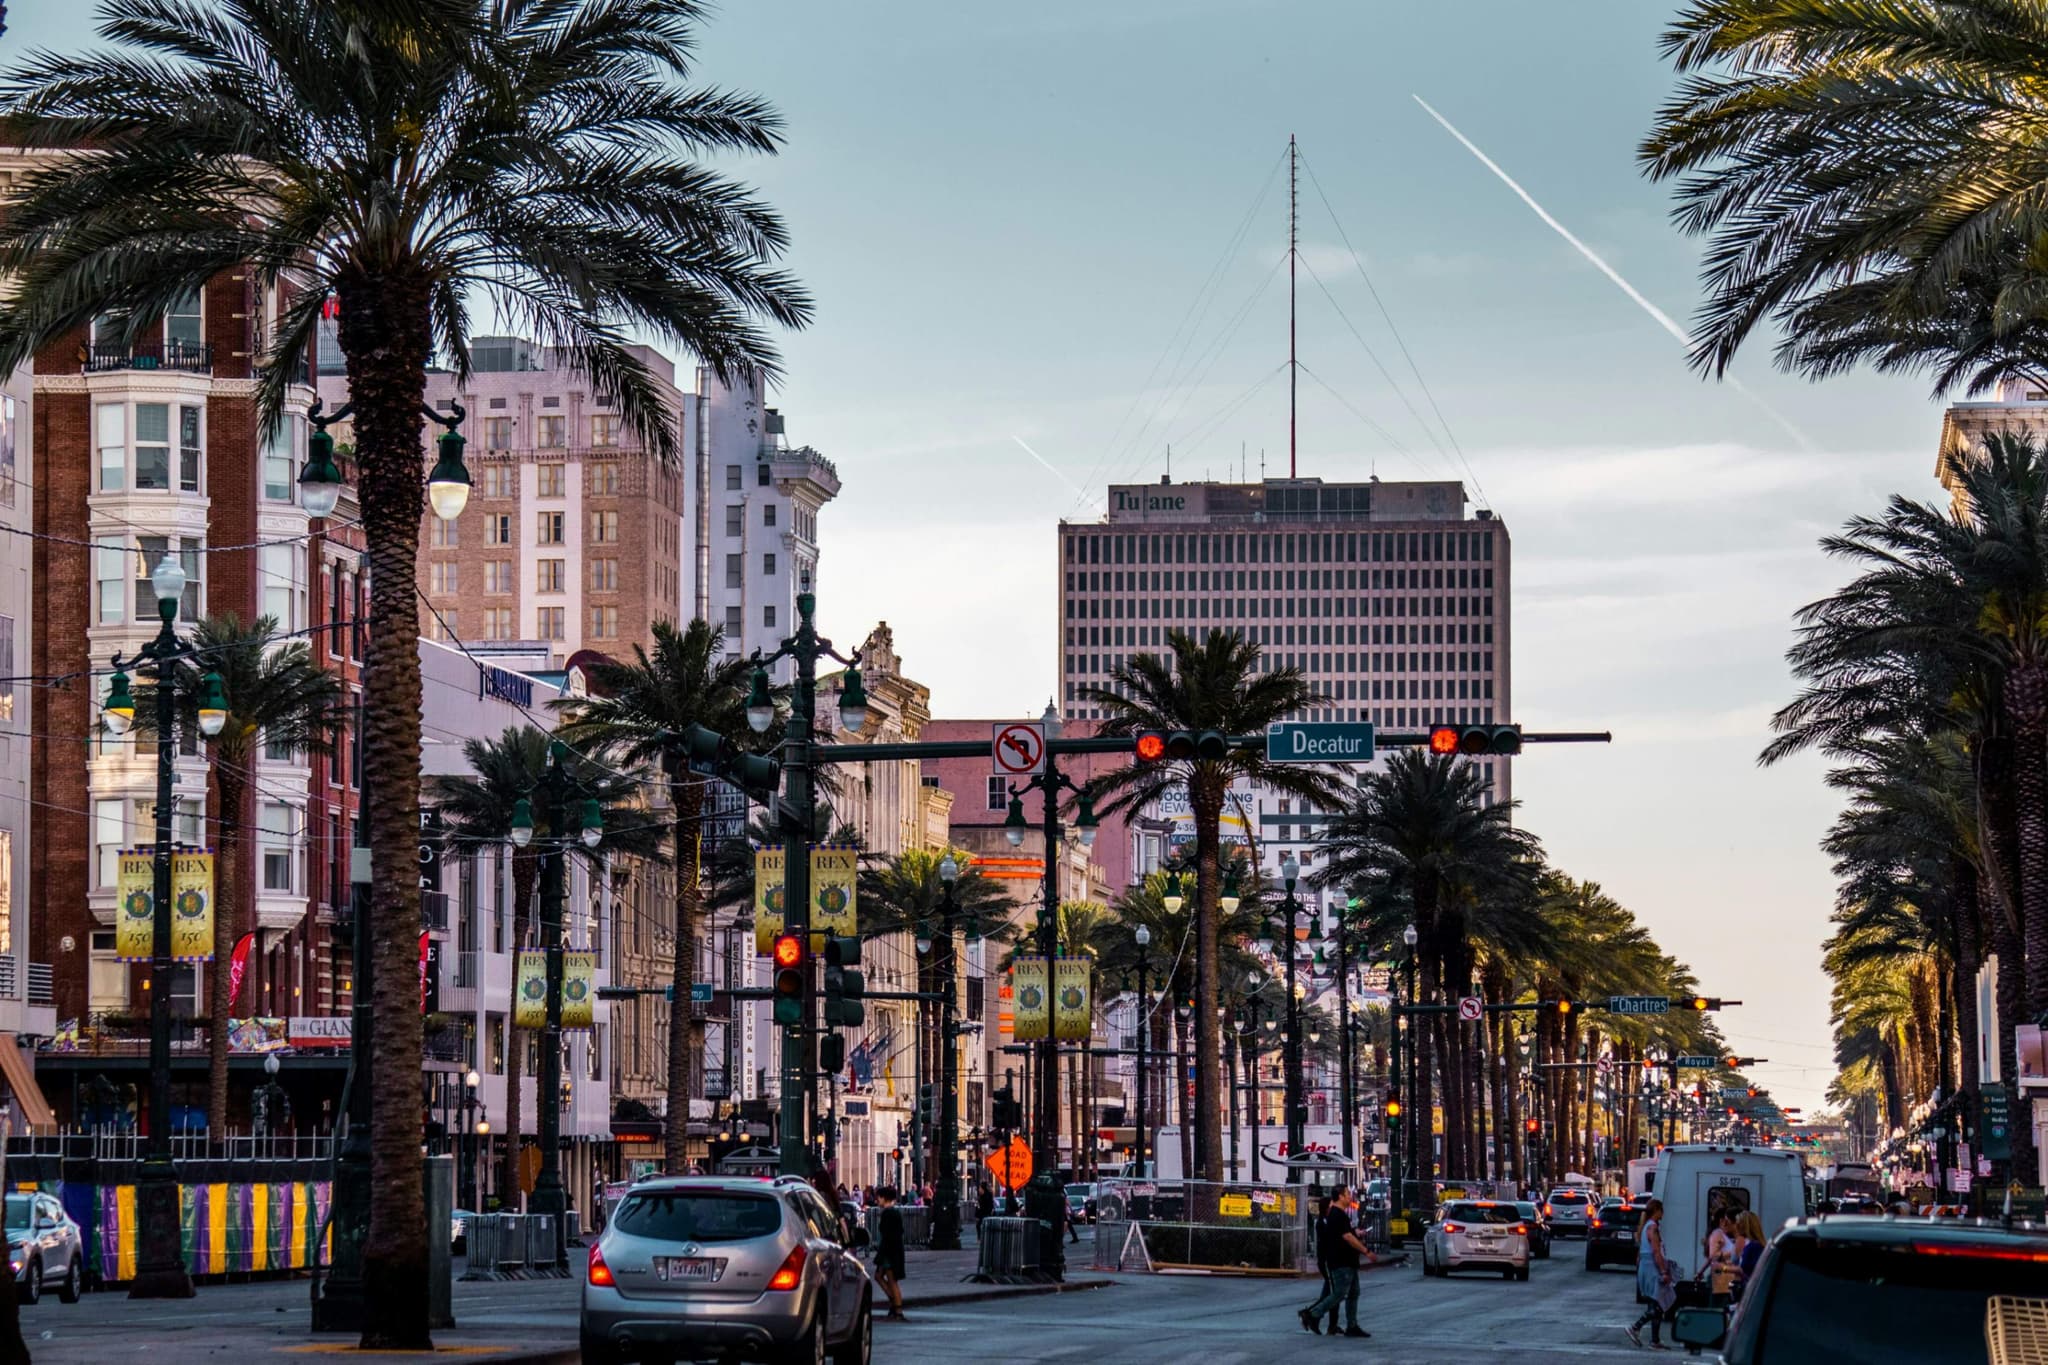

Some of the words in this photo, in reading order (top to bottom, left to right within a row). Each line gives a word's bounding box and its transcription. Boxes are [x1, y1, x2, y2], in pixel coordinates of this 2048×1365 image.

[1113, 490, 1185, 511] Tuane
[1293, 730, 1362, 754] Decatur
[1163, 792, 1190, 802] OOD
[123, 860, 155, 874] REX
[175, 860, 208, 873] REX
[762, 856, 784, 870] RE
[816, 856, 850, 869] REX
[1303, 893, 1317, 903] THE
[129, 932, 151, 946] 150
[181, 932, 202, 946] 150
[769, 928, 784, 938] 15
[565, 957, 591, 968] REX
[1017, 964, 1043, 976] REX
[1060, 964, 1085, 976] REX
[1619, 998, 1667, 1013] Chartres
[526, 1010, 542, 1020] 150
[1685, 1057, 1710, 1068] Royal
[1278, 1141, 1337, 1156] Rder
[1010, 1150, 1027, 1160] OAD
[999, 1171, 1027, 1180] AEAD
